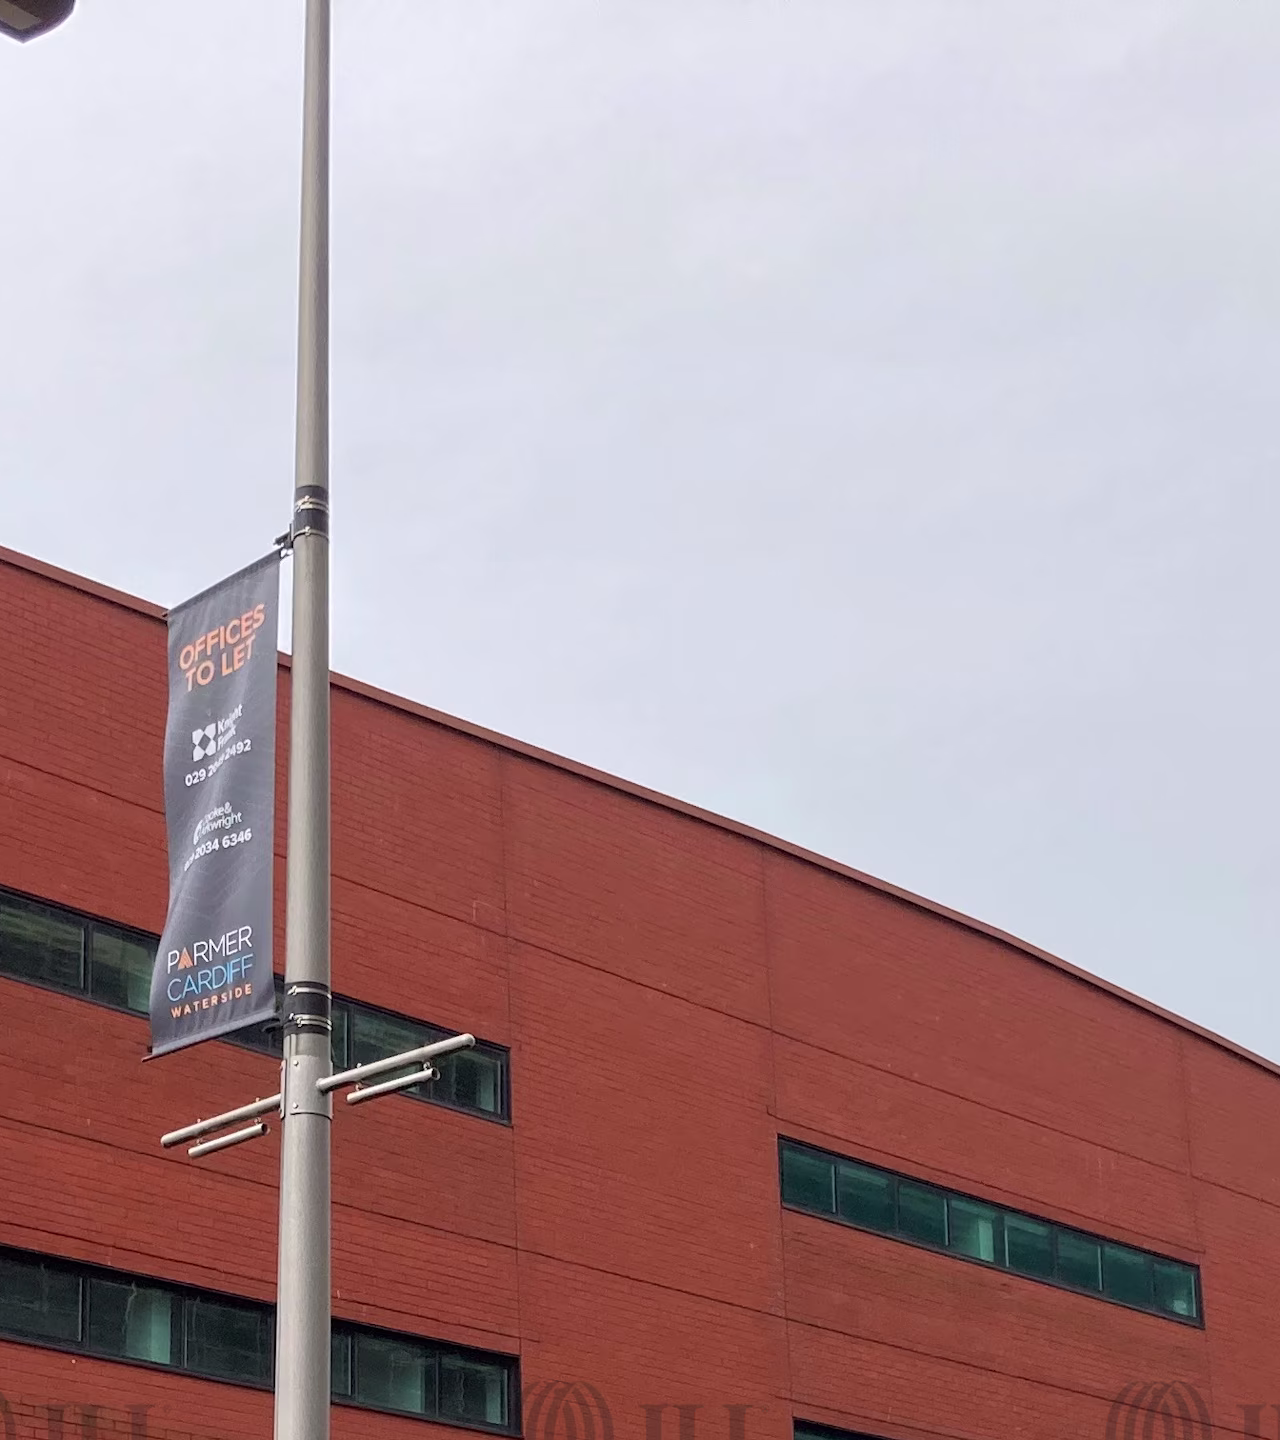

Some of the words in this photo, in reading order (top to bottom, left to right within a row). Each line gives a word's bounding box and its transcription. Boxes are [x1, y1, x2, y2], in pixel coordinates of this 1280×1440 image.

[179, 603, 265, 670] OFFICES
[185, 660, 215, 692] TO
[221, 634, 256, 677] LET
[185, 768, 207, 787] 029
[194, 838, 220, 860] 2034
[222, 828, 252, 849] 6346
[167, 925, 253, 974] PARMER
[167, 953, 254, 1002] CARDIFF
[170, 983, 253, 1018] WATERSIDE
